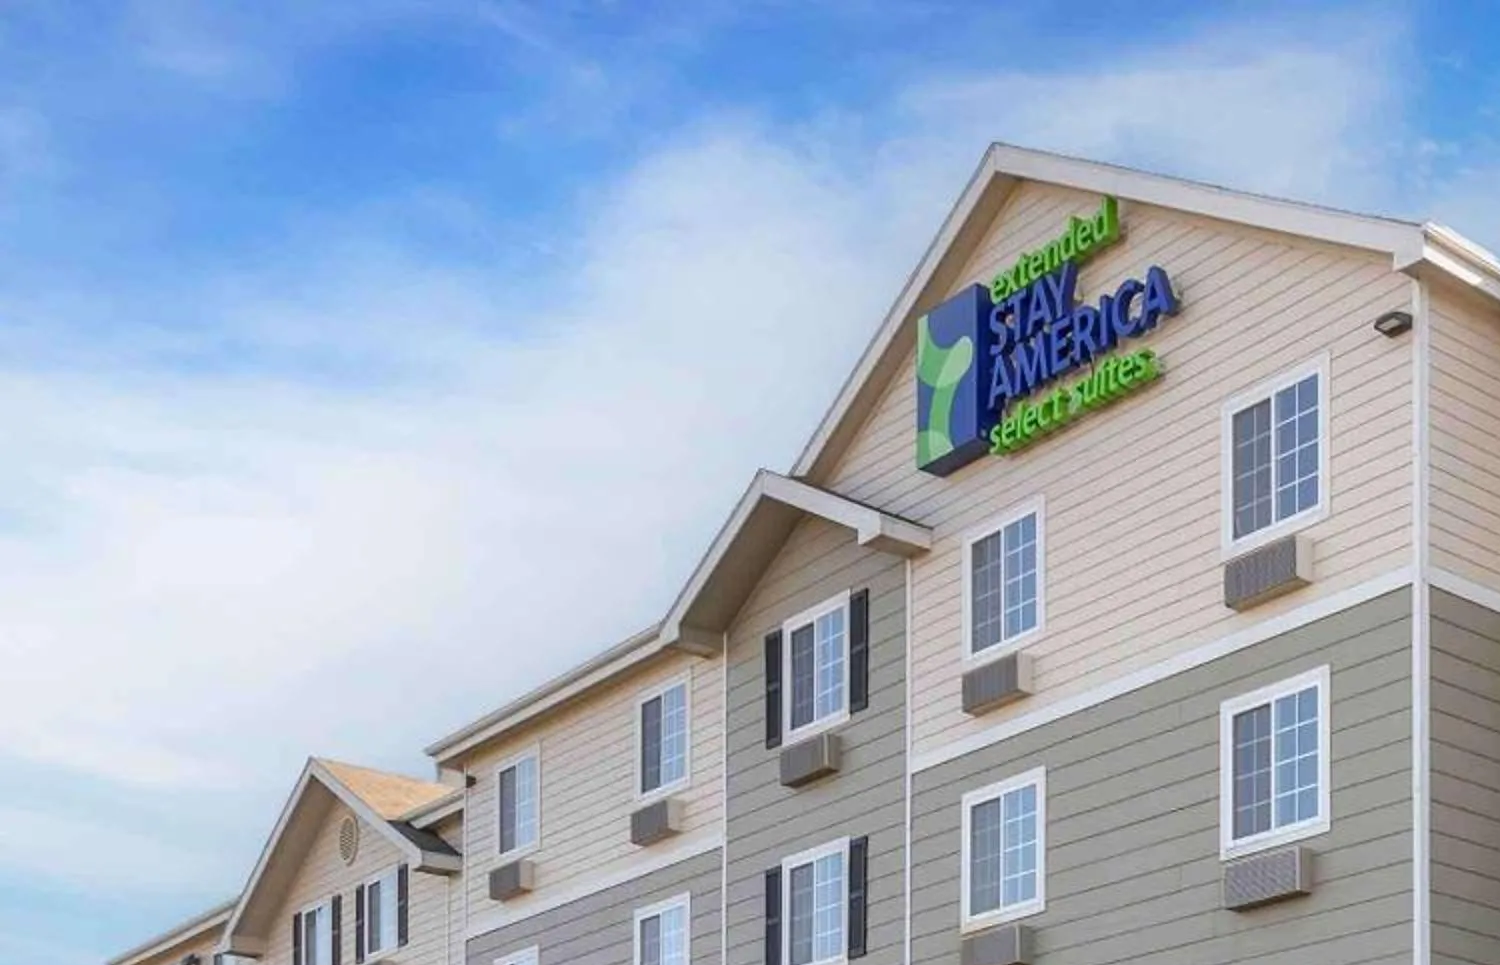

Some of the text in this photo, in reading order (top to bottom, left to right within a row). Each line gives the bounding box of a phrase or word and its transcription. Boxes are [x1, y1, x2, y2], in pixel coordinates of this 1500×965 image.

[989, 194, 1119, 303] extended
[988, 261, 1078, 350] STAY
[988, 265, 1179, 410] AMERICA
[989, 348, 1159, 455] select suites
